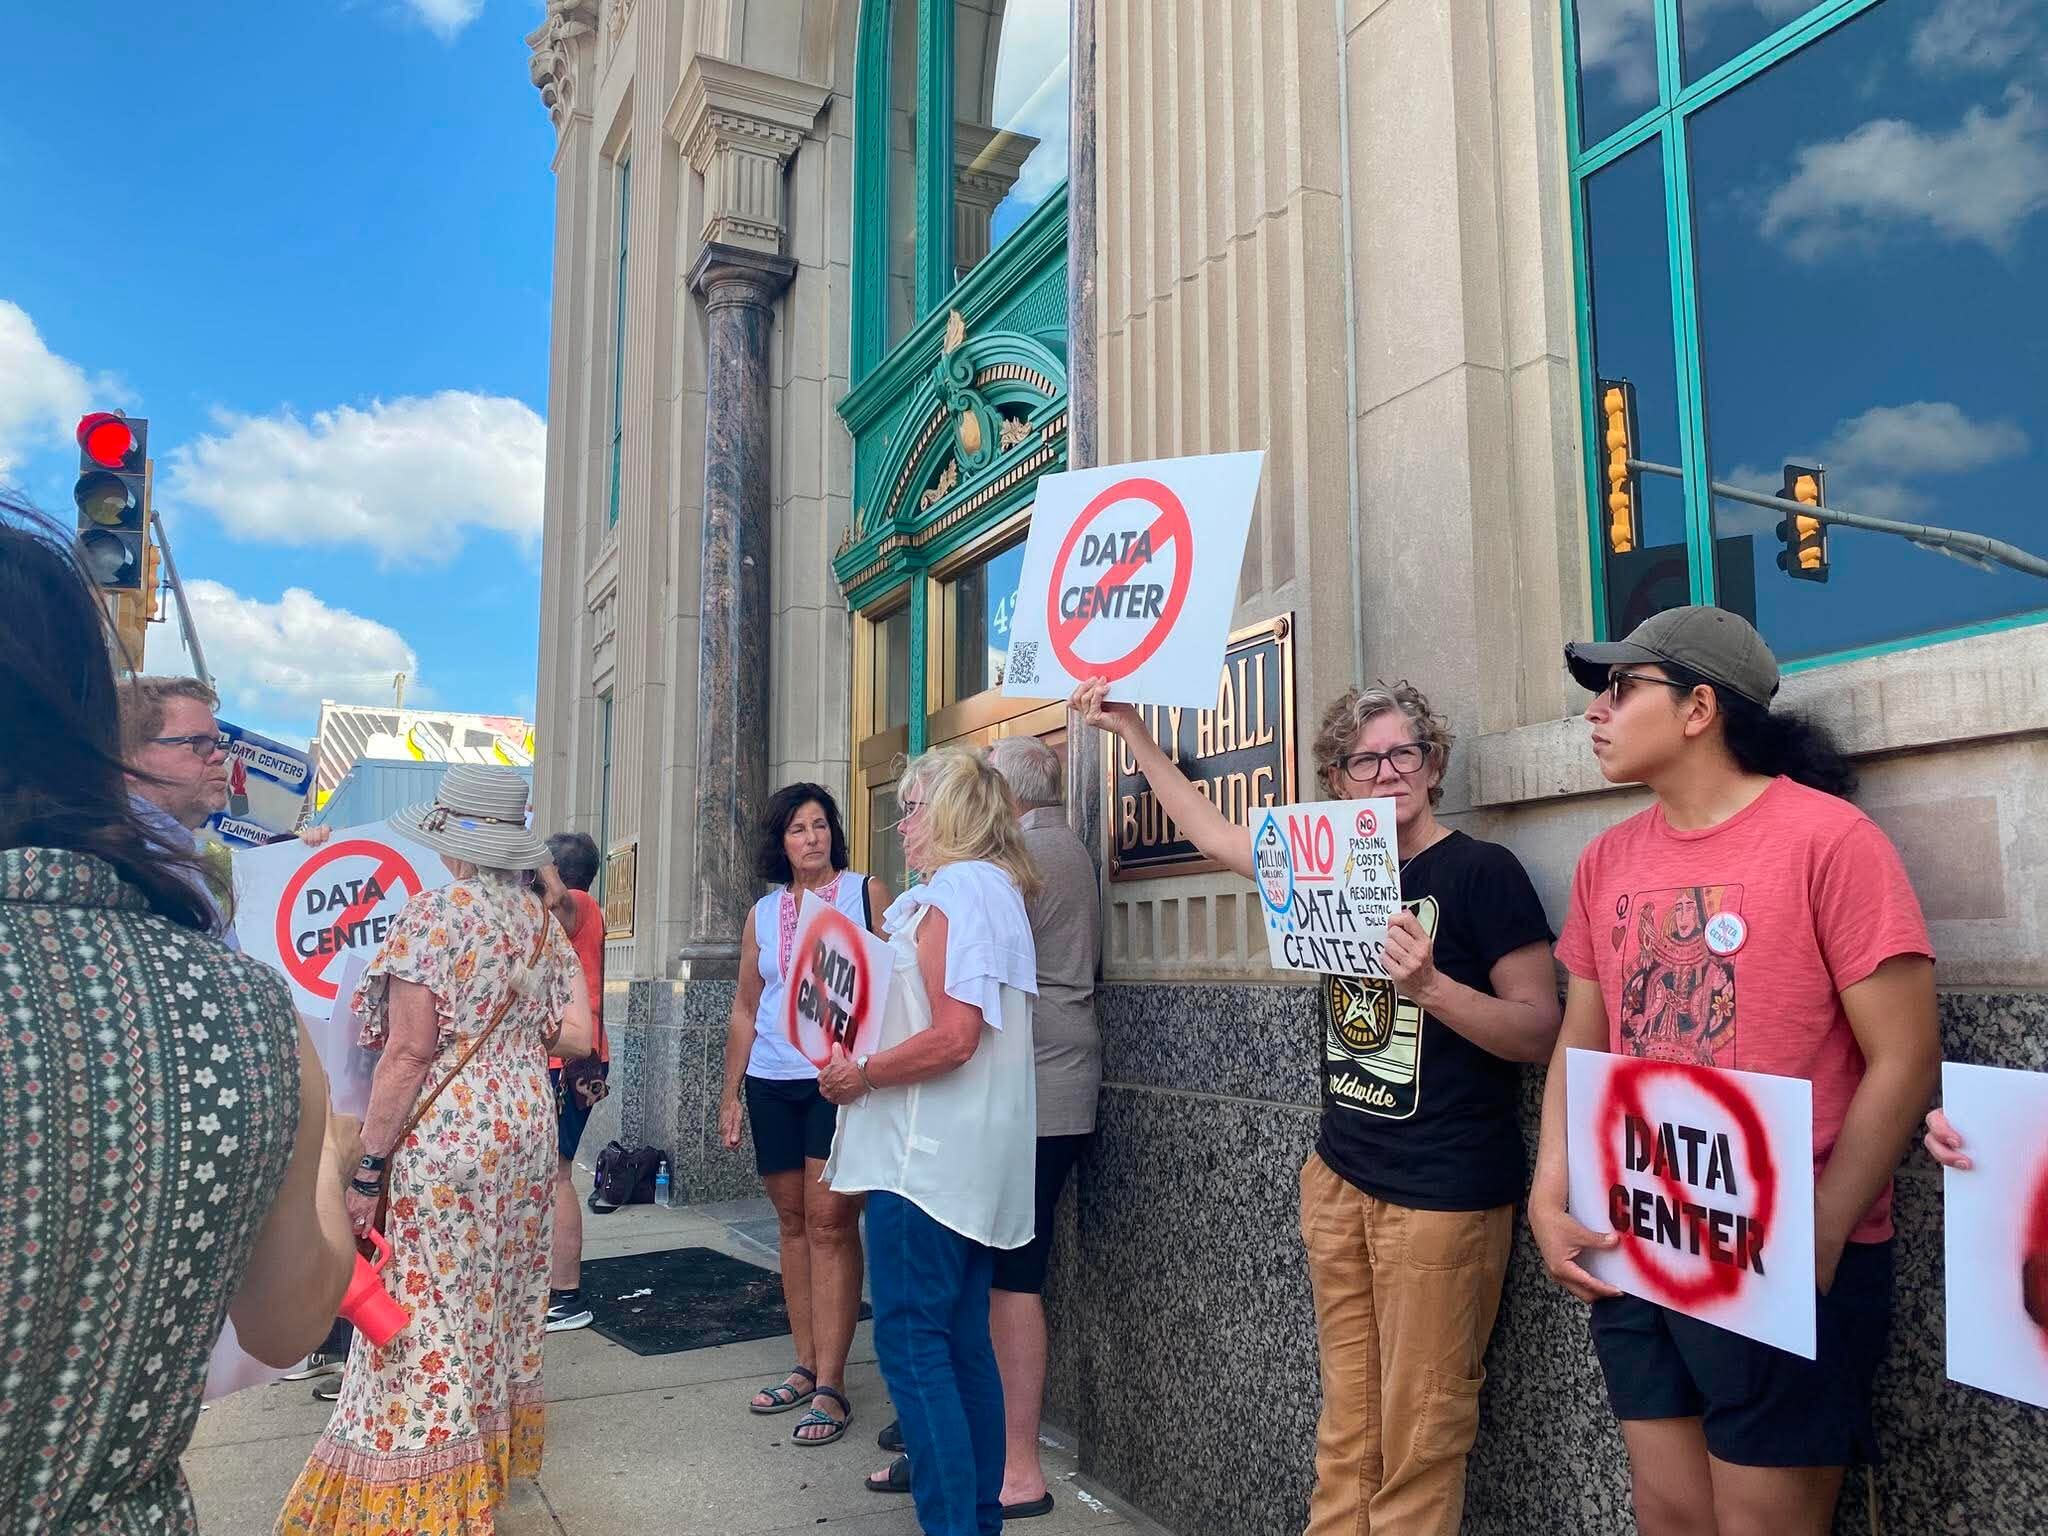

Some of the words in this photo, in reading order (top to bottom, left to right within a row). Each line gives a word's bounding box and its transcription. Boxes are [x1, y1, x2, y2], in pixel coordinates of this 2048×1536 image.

[1080, 530, 1152, 566] DATA
[1061, 583, 1164, 619] CENTER
[1196, 652, 1273, 760] HALL
[231, 743, 256, 762] DATA
[258, 753, 304, 778] CENTERS
[1265, 825, 1276, 846] 3
[1359, 819, 1373, 831] NO
[1257, 850, 1288, 869] MILLION
[1288, 814, 1335, 875] NO
[1349, 837, 1387, 850] PASSING
[1356, 853, 1384, 867] COSTS
[1363, 868, 1377, 882] TO
[306, 877, 385, 915] DATA
[1292, 888, 1356, 933] DATA
[1349, 886, 1399, 902] RESIDENTS
[1357, 904, 1393, 915] ELECTRIC
[1616, 894, 1629, 921] Q
[296, 914, 397, 958] CENTE
[1364, 916, 1387, 927] BILLS
[812, 938, 856, 1004] DATA
[1624, 1113, 1738, 1196] DATA
[1608, 1183, 1766, 1276] CENTER
